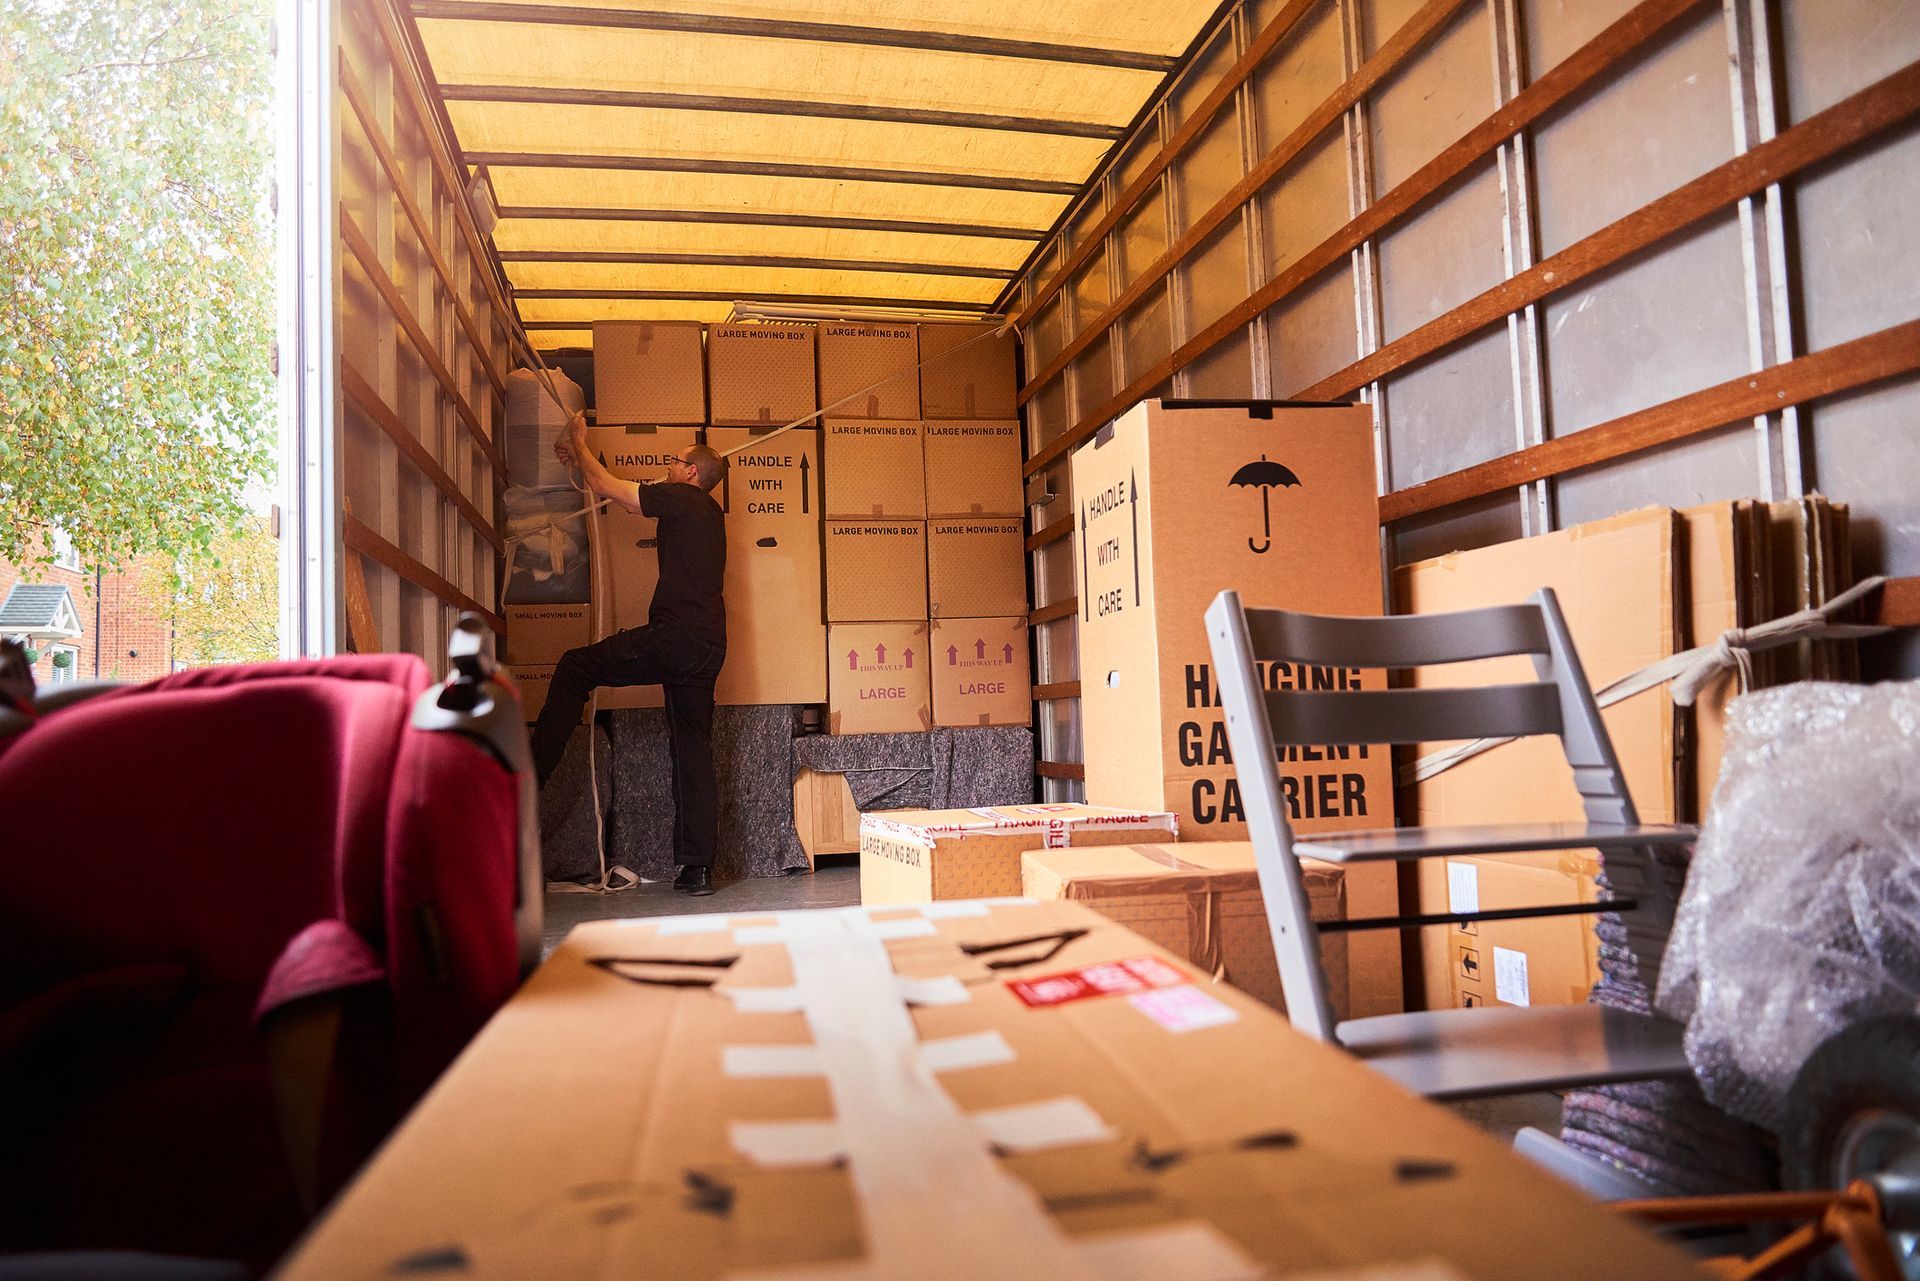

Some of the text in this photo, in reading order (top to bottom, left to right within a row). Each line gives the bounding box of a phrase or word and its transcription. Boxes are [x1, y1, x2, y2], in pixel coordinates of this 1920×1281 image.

[717, 329, 805, 340] LARGE MOVING BOX
[826, 328, 911, 339] LARGE MOVING BOX
[832, 426, 917, 436] LARGE MOVING BOX
[931, 427, 1014, 436] LARGE MOVING BOX
[615, 454, 671, 466] HANDLE
[738, 455, 792, 467] HANDLE
[749, 479, 783, 491] WITH
[1090, 480, 1125, 522] HANDLE
[747, 502, 785, 514] CARE
[833, 527, 919, 536] LARGE MOVING BOX
[935, 525, 1018, 535] LARGE MOVING BOX
[1097, 537, 1120, 567] WITH
[1098, 588, 1122, 617] CARE
[514, 612, 538, 620] SMALL
[540, 611, 567, 619] MOVING
[860, 665, 877, 673] THIS
[877, 664, 892, 672] WAY
[959, 660, 976, 668] THIS
[976, 659, 992, 667] WAY
[860, 687, 906, 700] LARGE
[959, 682, 1006, 695] LARGE
[1192, 773, 1368, 825] CARIER
[862, 835, 921, 868] LARGE MOVING BOX
